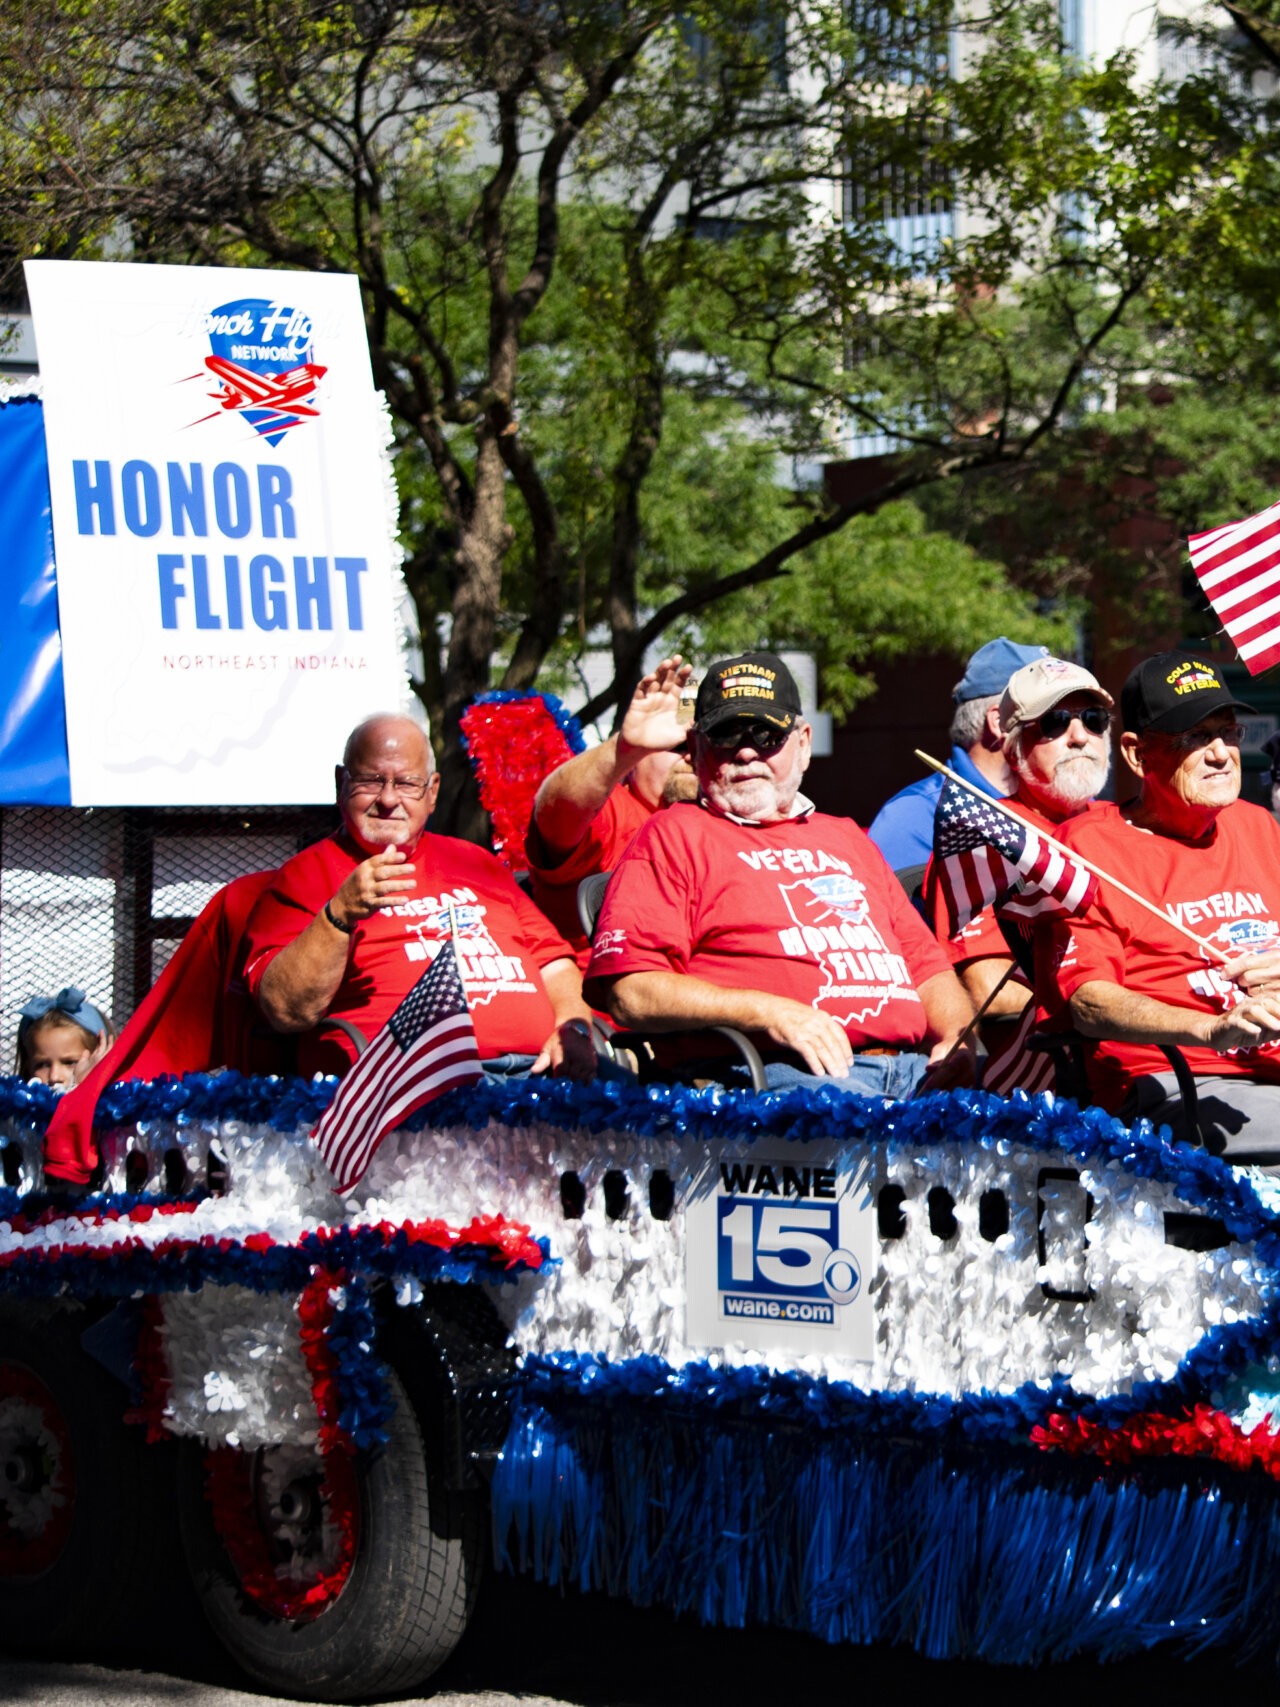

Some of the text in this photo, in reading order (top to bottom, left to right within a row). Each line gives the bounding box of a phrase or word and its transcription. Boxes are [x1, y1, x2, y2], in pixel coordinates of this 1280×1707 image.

[230, 344, 299, 362] NETWORK
[72, 459, 297, 539] HONOR
[157, 554, 368, 632] FLIGHT
[162, 654, 369, 670] NORTHEAST INDIANA
[719, 663, 776, 681] VIETNAM
[1166, 661, 1215, 684] COLD WAR
[721, 686, 775, 700] VETERAN
[1174, 679, 1221, 695] VETERAN
[1166, 892, 1270, 927] VETERAN
[404, 936, 496, 963] HOOR
[778, 923, 883, 956] HONOR
[457, 955, 527, 980] LIGHT
[827, 951, 912, 985] FLIGHT
[719, 1162, 837, 1199] WANE
[721, 1204, 834, 1287] 15
[726, 1298, 832, 1322] wane.com
